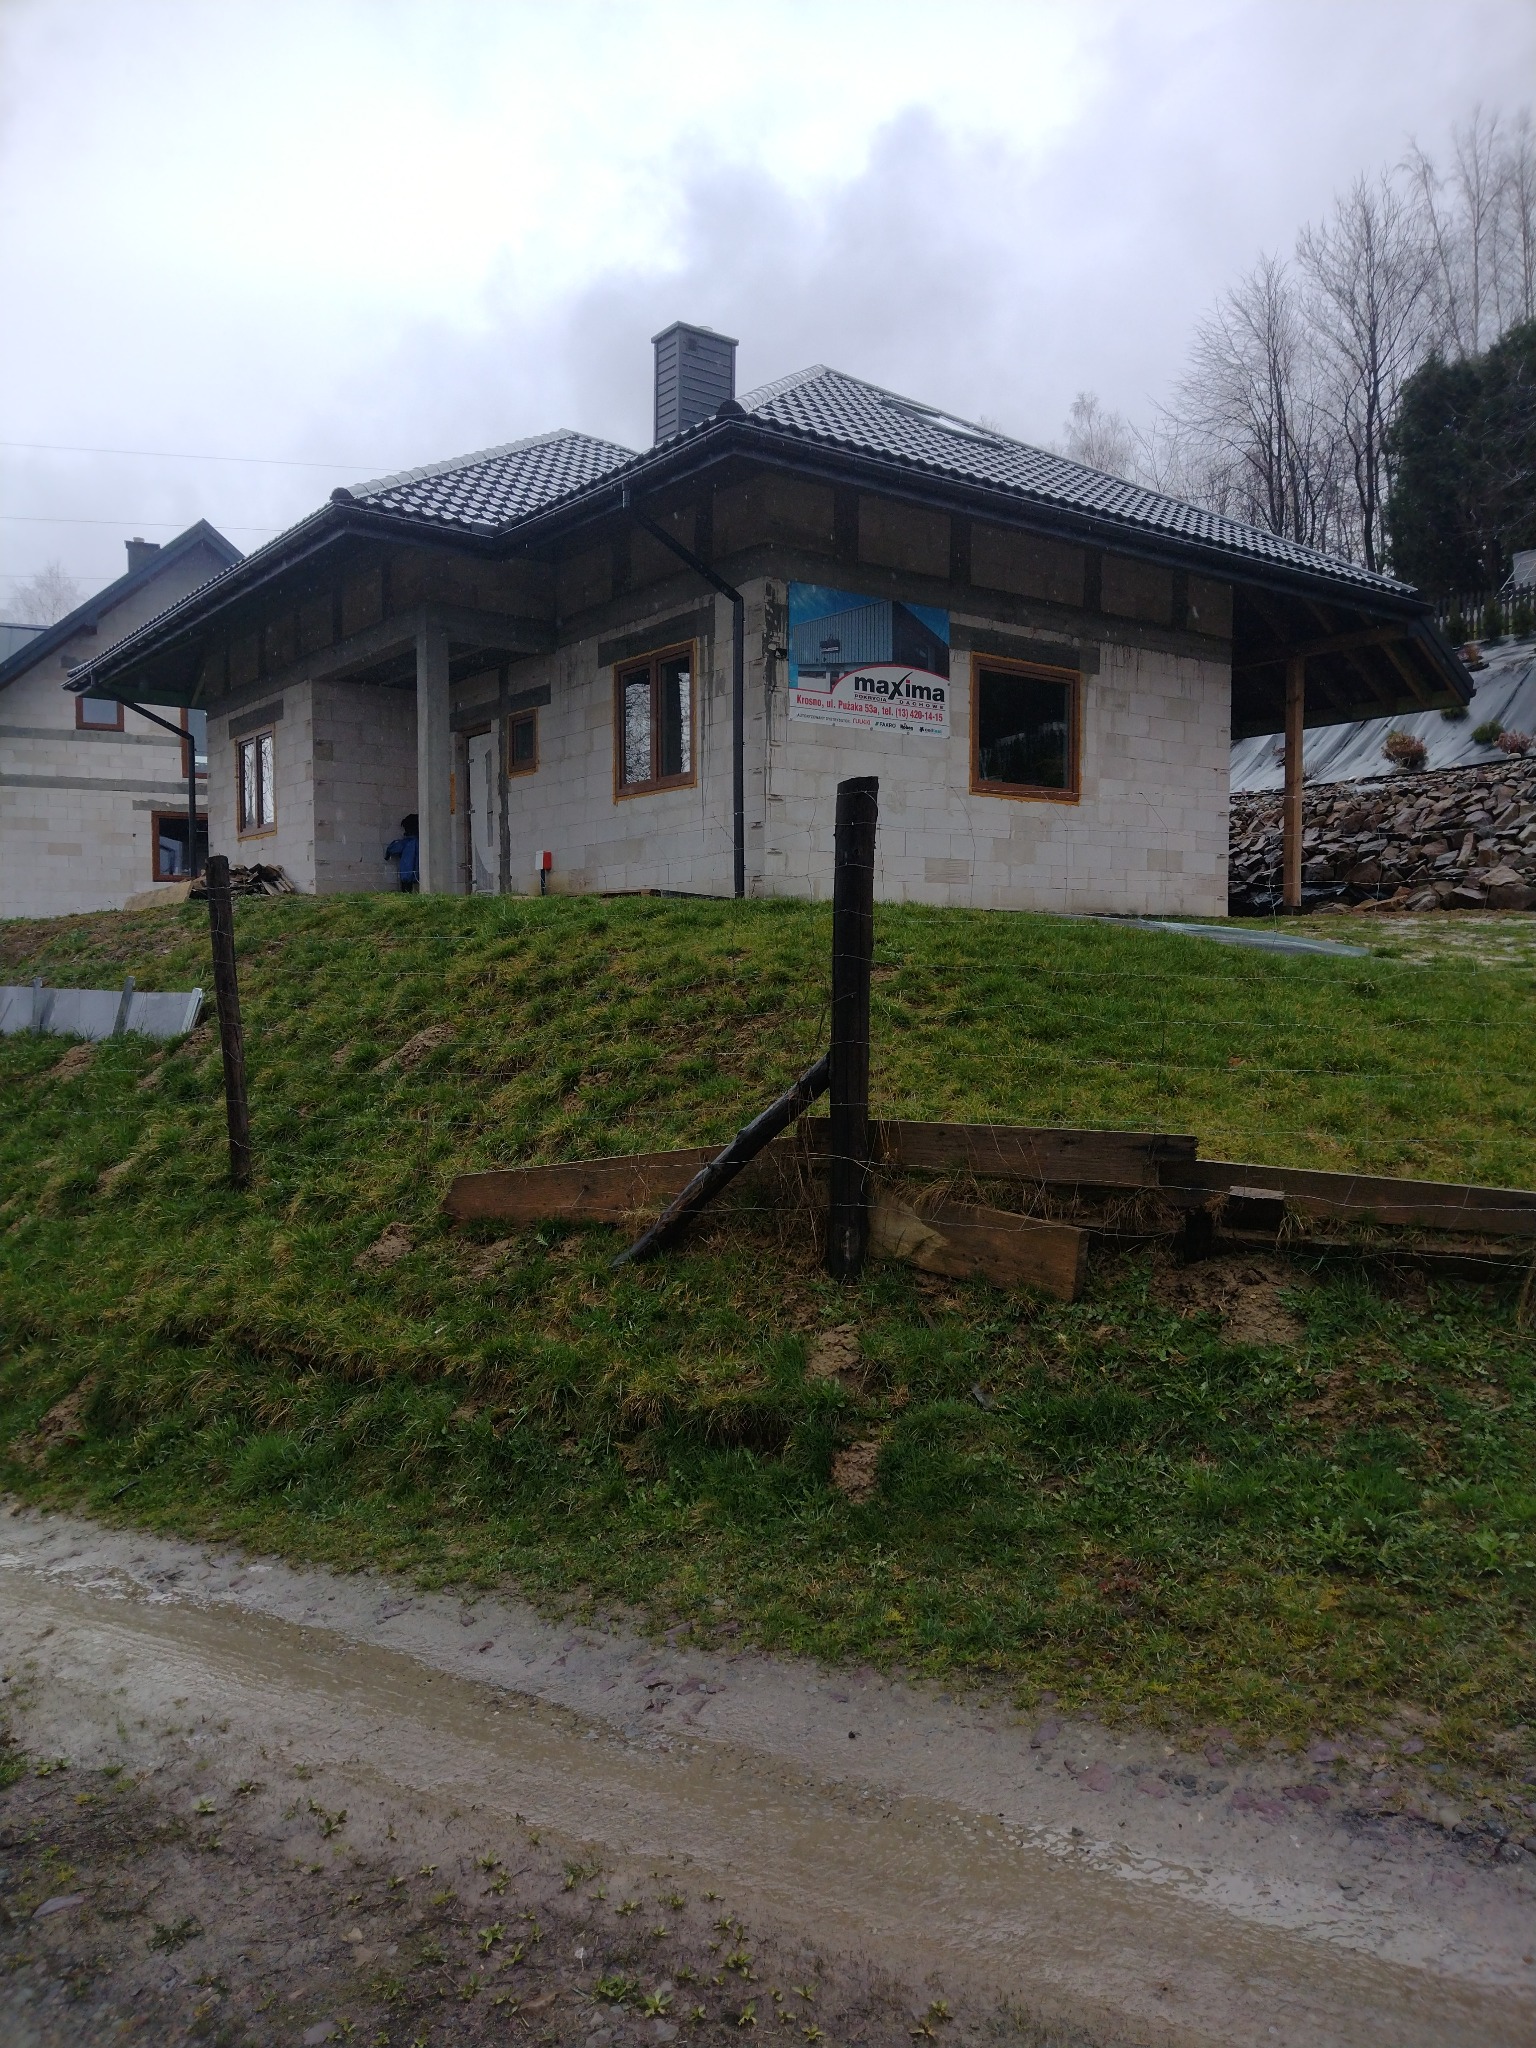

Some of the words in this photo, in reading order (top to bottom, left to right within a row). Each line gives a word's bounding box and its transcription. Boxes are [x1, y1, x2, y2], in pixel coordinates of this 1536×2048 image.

[854, 671, 945, 703] maxima
[796, 694, 825, 709] Krosno,
[826, 698, 836, 709] ul.
[838, 700, 863, 712] Pużaka
[864, 703, 880, 716] 53a,
[882, 706, 894, 717] tel.
[895, 707, 909, 719] (13)
[909, 708, 943, 722] 420-14-15
[854, 694, 887, 703] POKRYCIA
[899, 700, 944, 710] DACHOWE
